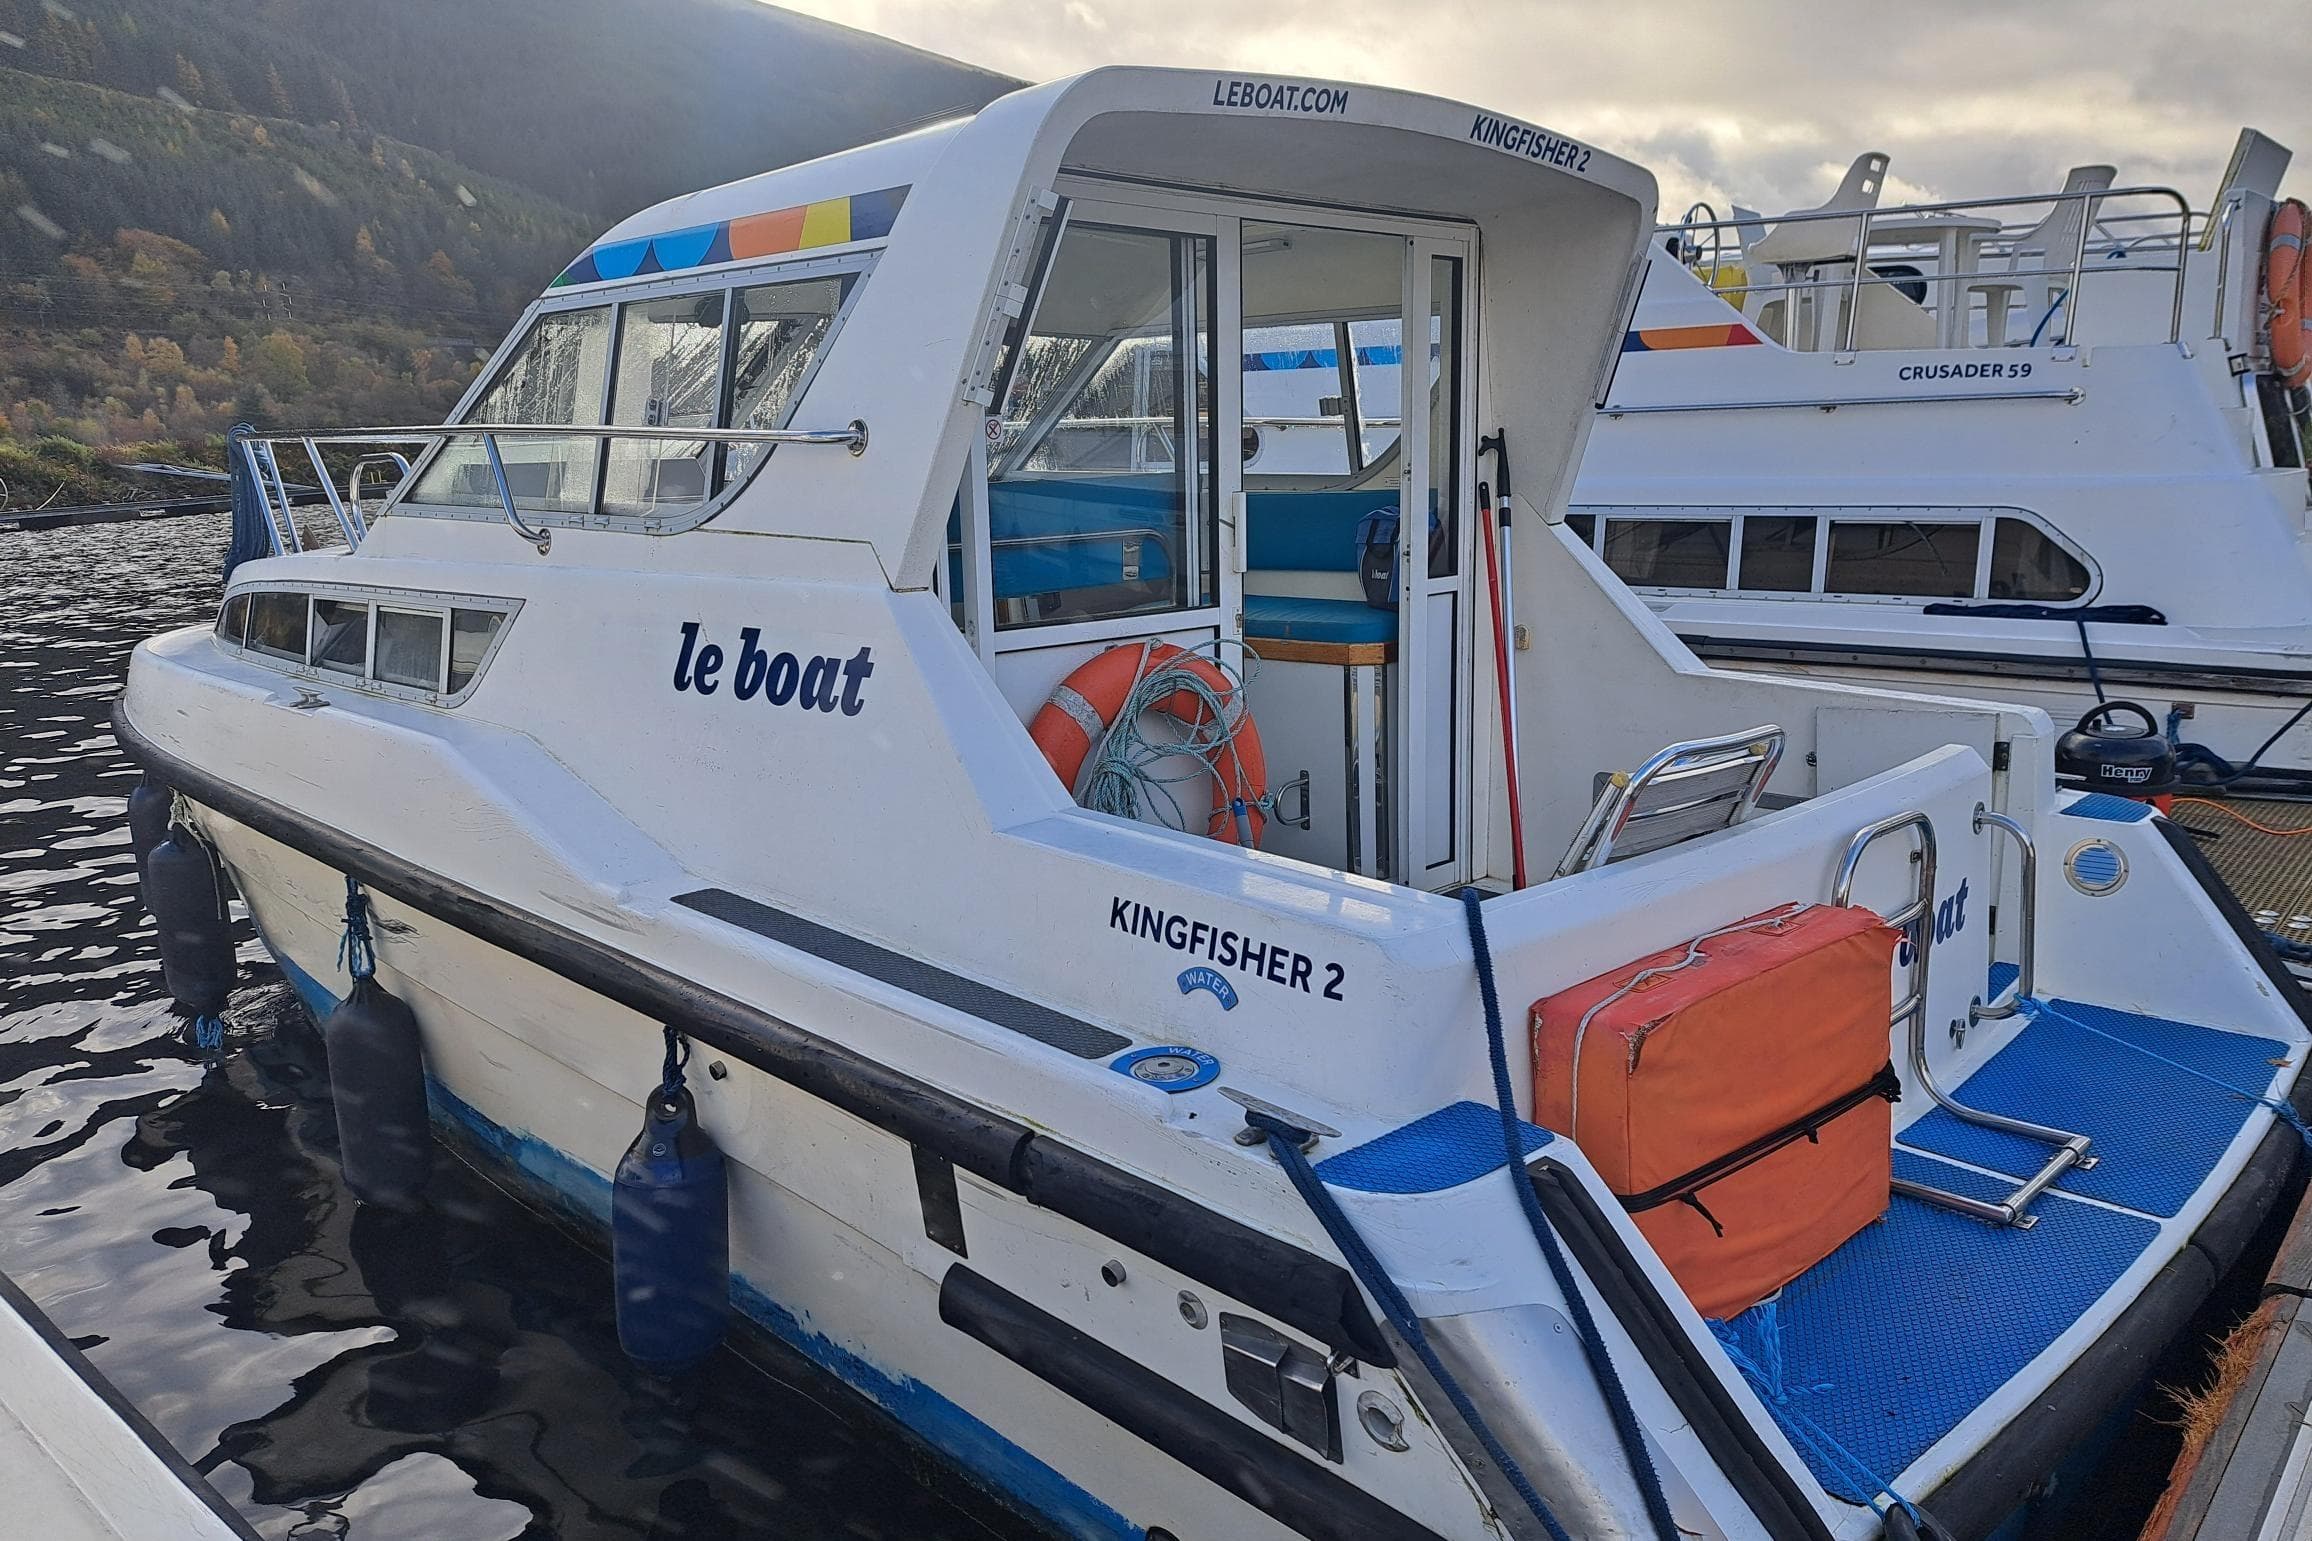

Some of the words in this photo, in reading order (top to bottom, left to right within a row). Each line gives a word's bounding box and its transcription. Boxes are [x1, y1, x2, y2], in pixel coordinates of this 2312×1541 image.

[1213, 80, 1349, 114] LEBOAT.COM
[1469, 114, 1579, 169] KINGFISHER
[1577, 150, 1591, 172] 2
[1898, 363, 2003, 380] CRUSADER
[2007, 363, 2033, 378] 59
[673, 621, 724, 695] le
[734, 627, 875, 717] boat
[2101, 764, 2153, 781] Henry
[1109, 896, 1313, 994] KINGFISHER
[1323, 962, 1345, 1001] 2
[1185, 973, 1230, 1000] WATER
[1168, 1047, 1215, 1066] WATER
